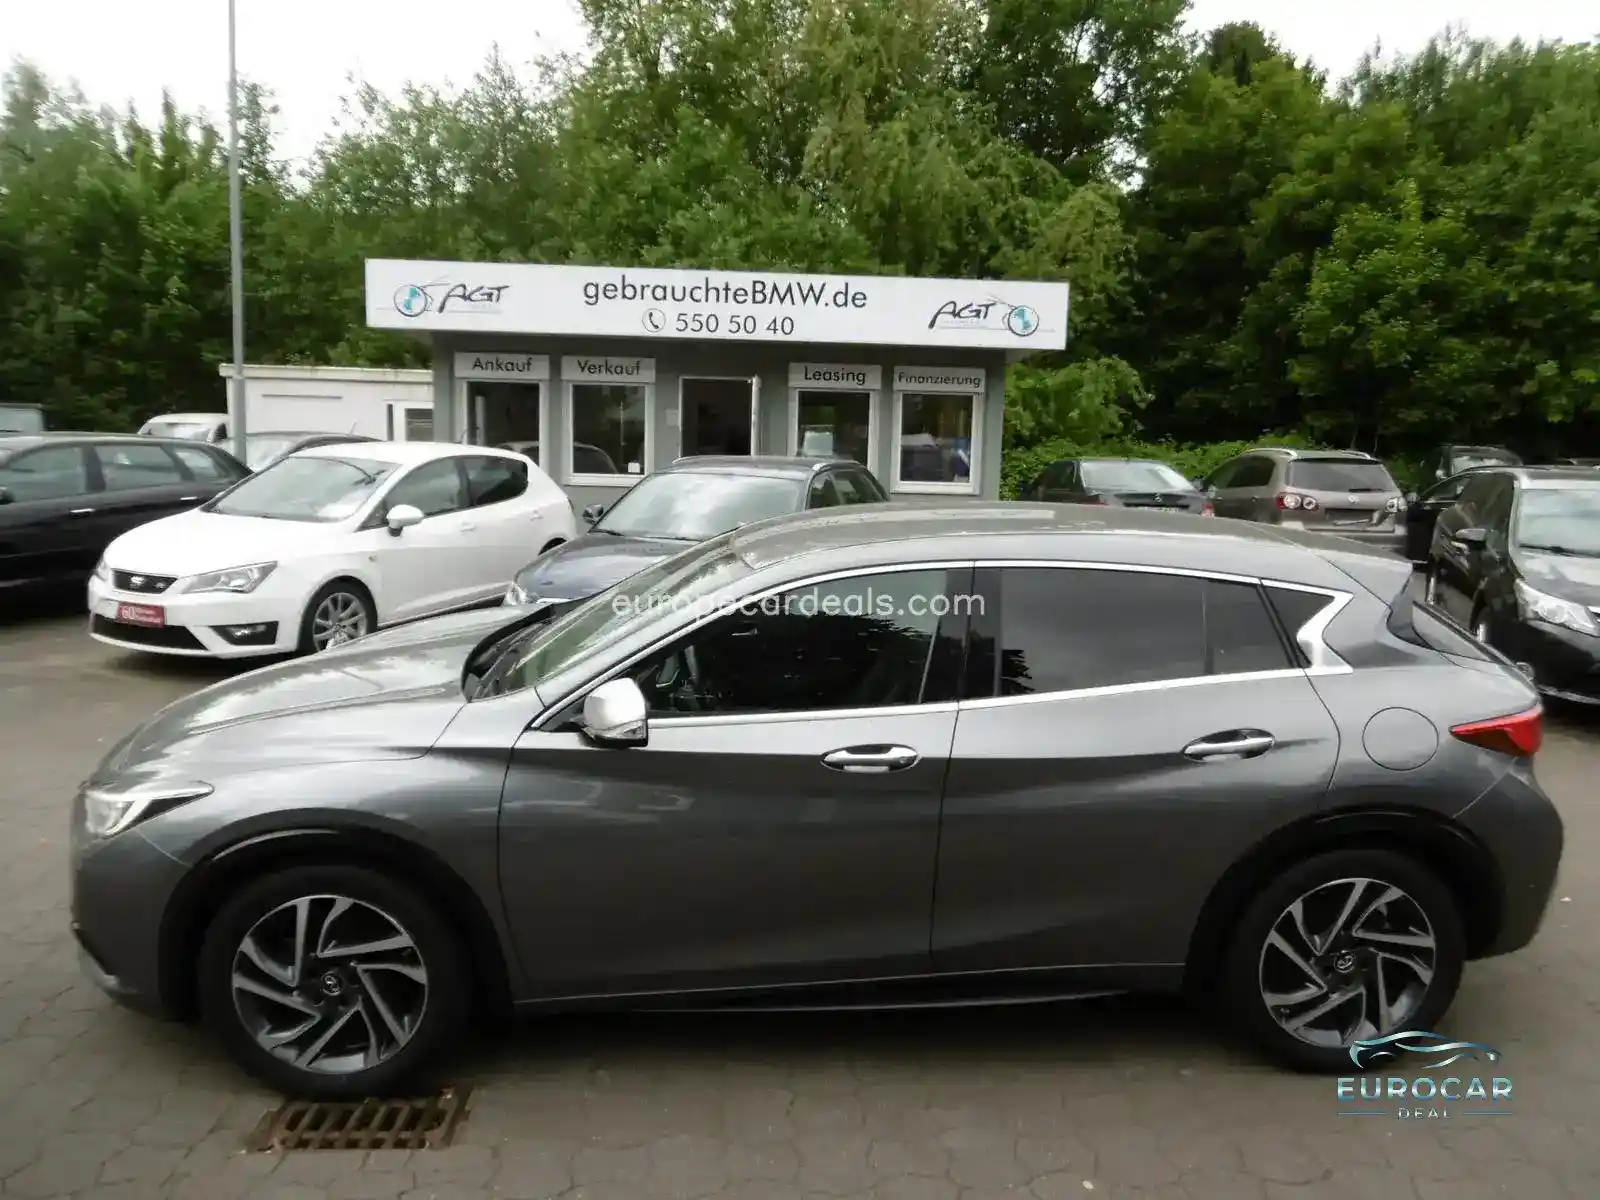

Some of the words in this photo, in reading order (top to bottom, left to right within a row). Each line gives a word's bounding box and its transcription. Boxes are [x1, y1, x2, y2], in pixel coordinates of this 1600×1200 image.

[437, 283, 510, 314] AGT
[583, 275, 868, 308] gebrauchteBMW.de
[675, 313, 719, 333] 550
[728, 315, 757, 334] 50
[766, 316, 795, 335] 40
[928, 301, 997, 329] AGT
[472, 357, 533, 373] Ankauf
[577, 359, 642, 376] Verkauf
[804, 366, 866, 386] Leasing
[898, 372, 981, 388] Finanzierung
